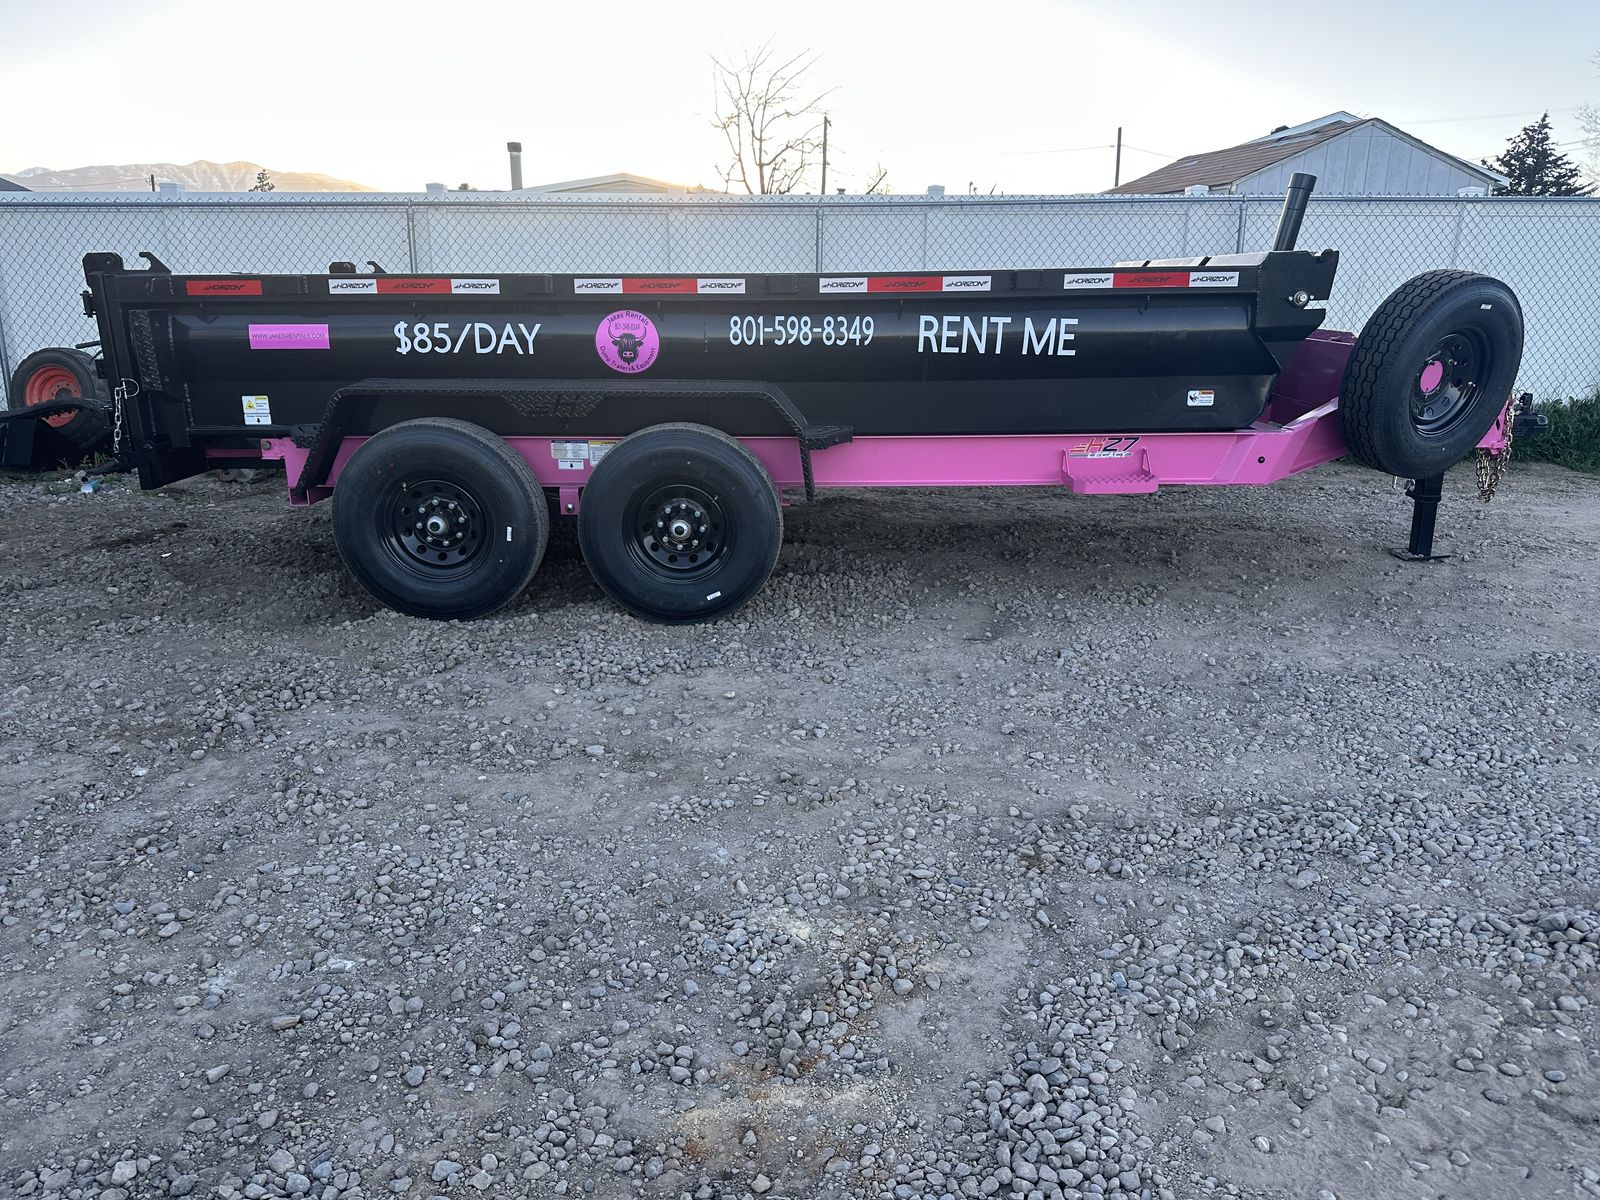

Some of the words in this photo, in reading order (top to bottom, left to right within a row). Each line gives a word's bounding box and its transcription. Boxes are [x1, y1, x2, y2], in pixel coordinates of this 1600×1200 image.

[607, 313, 624, 324] Jakes
[625, 310, 649, 326] Rentals
[729, 315, 875, 346] 801-598-8349
[393, 320, 542, 355] $85/DAY
[917, 315, 1012, 354] RENT
[1021, 317, 1079, 356] ME
[600, 345, 611, 362] Dump
